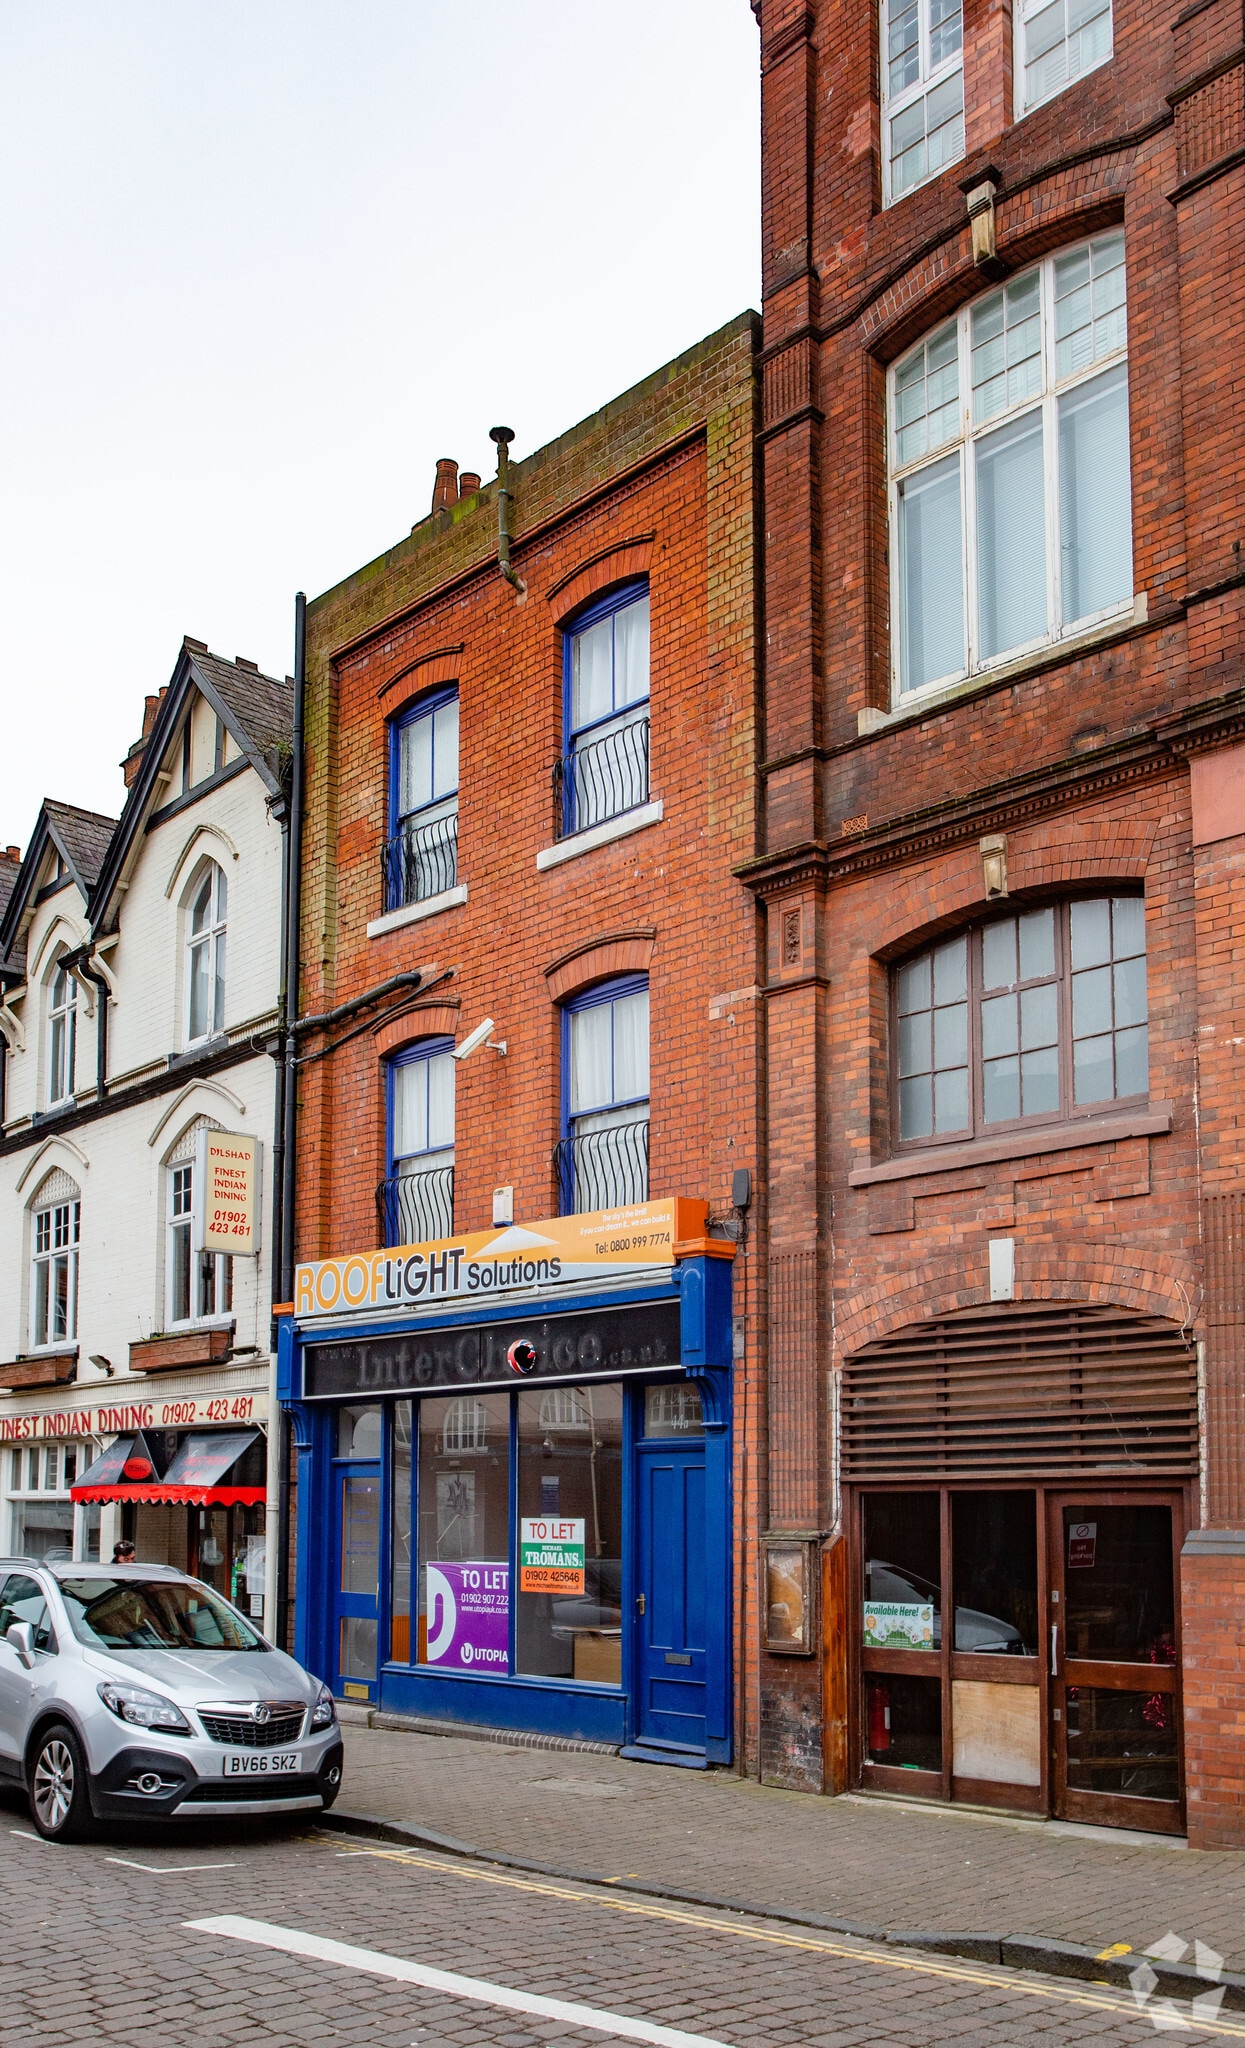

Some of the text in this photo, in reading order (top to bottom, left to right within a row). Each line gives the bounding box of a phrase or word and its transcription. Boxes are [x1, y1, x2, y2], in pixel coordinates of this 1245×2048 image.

[209, 1147, 251, 1160] DILSHAD
[214, 1167, 247, 1178] FINEST
[214, 1179, 247, 1190] INDIAN
[214, 1190, 247, 1202] DINING
[214, 1210, 247, 1223] 01902
[209, 1222, 251, 1236] 423 481
[595, 1232, 670, 1254] Tel: 0800 999 7774
[467, 1256, 561, 1290] Solutions
[0, 1416, 40, 1440] INEST
[43, 1410, 92, 1439] INDIAN
[97, 1403, 154, 1432] DINING
[162, 1402, 196, 1425] 01902
[206, 1399, 229, 1421] 423
[231, 1396, 253, 1419] 481
[529, 1522, 576, 1540] TO LET
[525, 1551, 579, 1567] TROMANS
[461, 1570, 509, 1590] TO LET
[525, 1570, 580, 1583] 01902 425646
[461, 1593, 509, 1606] 01902 907 222
[865, 1604, 919, 1617] Available Here!
[474, 1648, 509, 1663] UTOPIA
[231, 1755, 297, 1772] BV66 SKZ
